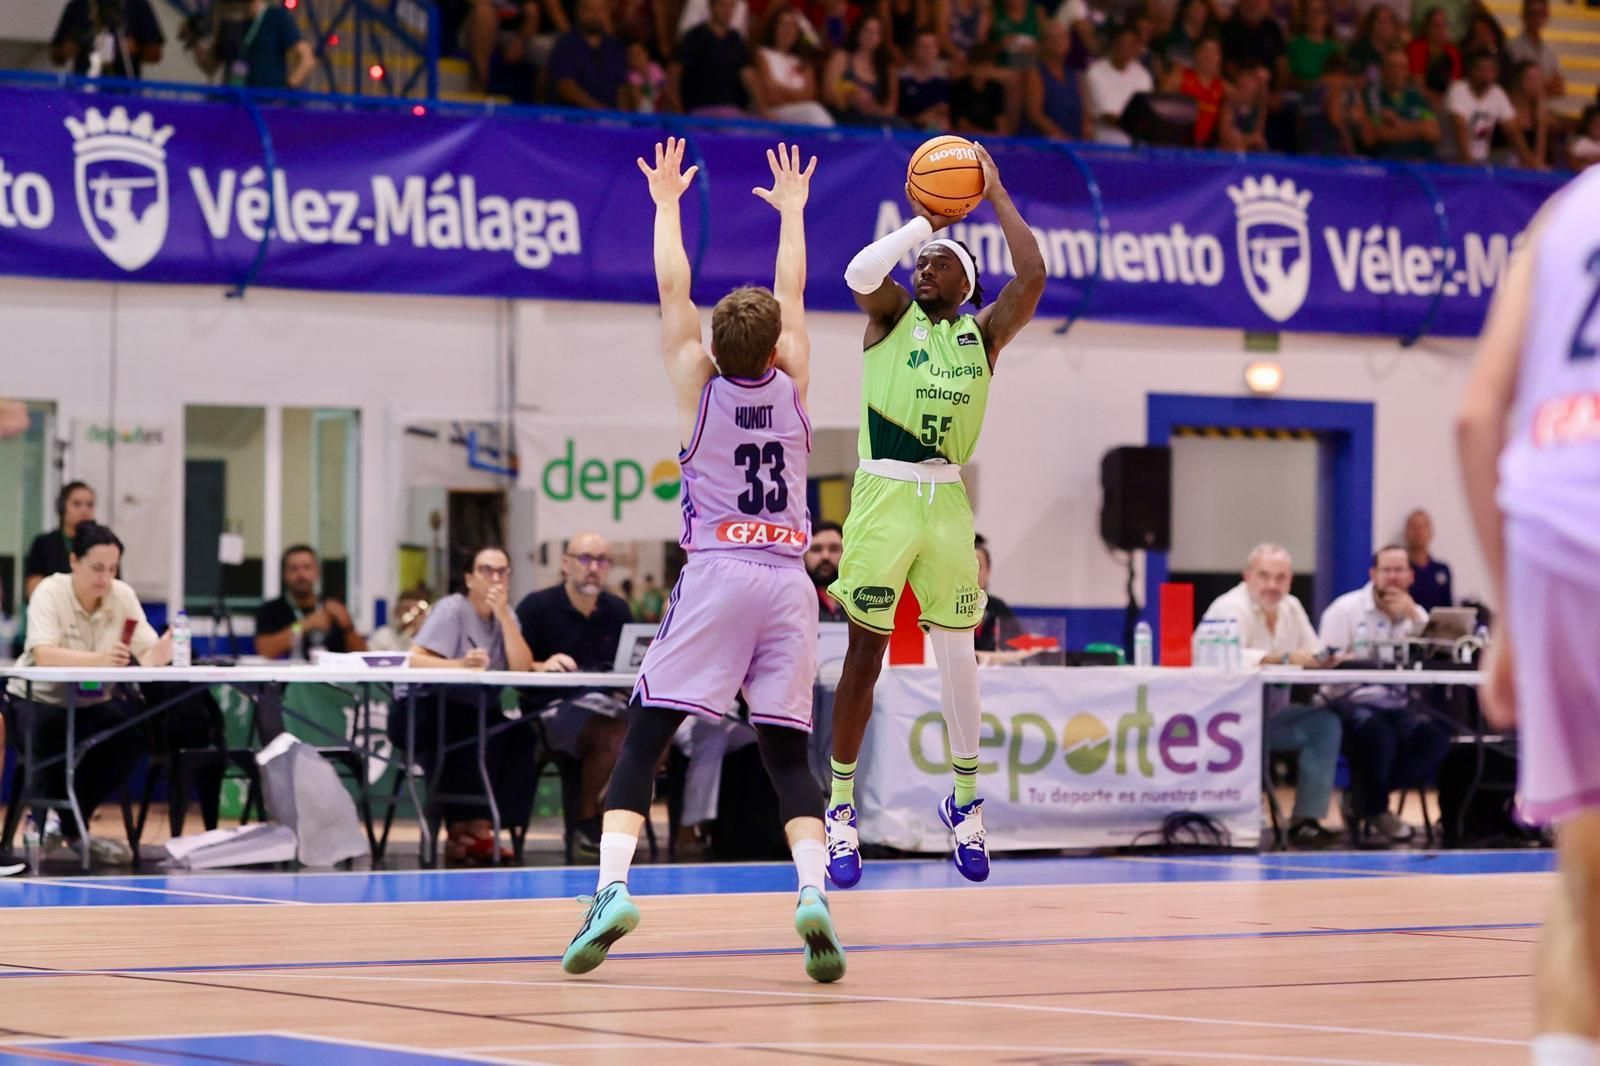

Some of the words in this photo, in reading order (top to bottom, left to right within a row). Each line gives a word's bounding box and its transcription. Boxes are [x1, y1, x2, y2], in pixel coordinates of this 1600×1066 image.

[189, 166, 581, 269] Vélez-Málaga
[930, 363, 983, 379] Unicaja
[916, 384, 970, 405] málaga
[735, 406, 773, 429] HUNDT
[734, 441, 788, 515] 33
[1028, 787, 1046, 802] Tu
[1051, 787, 1113, 804] deporte
[1118, 790, 1136, 802] es
